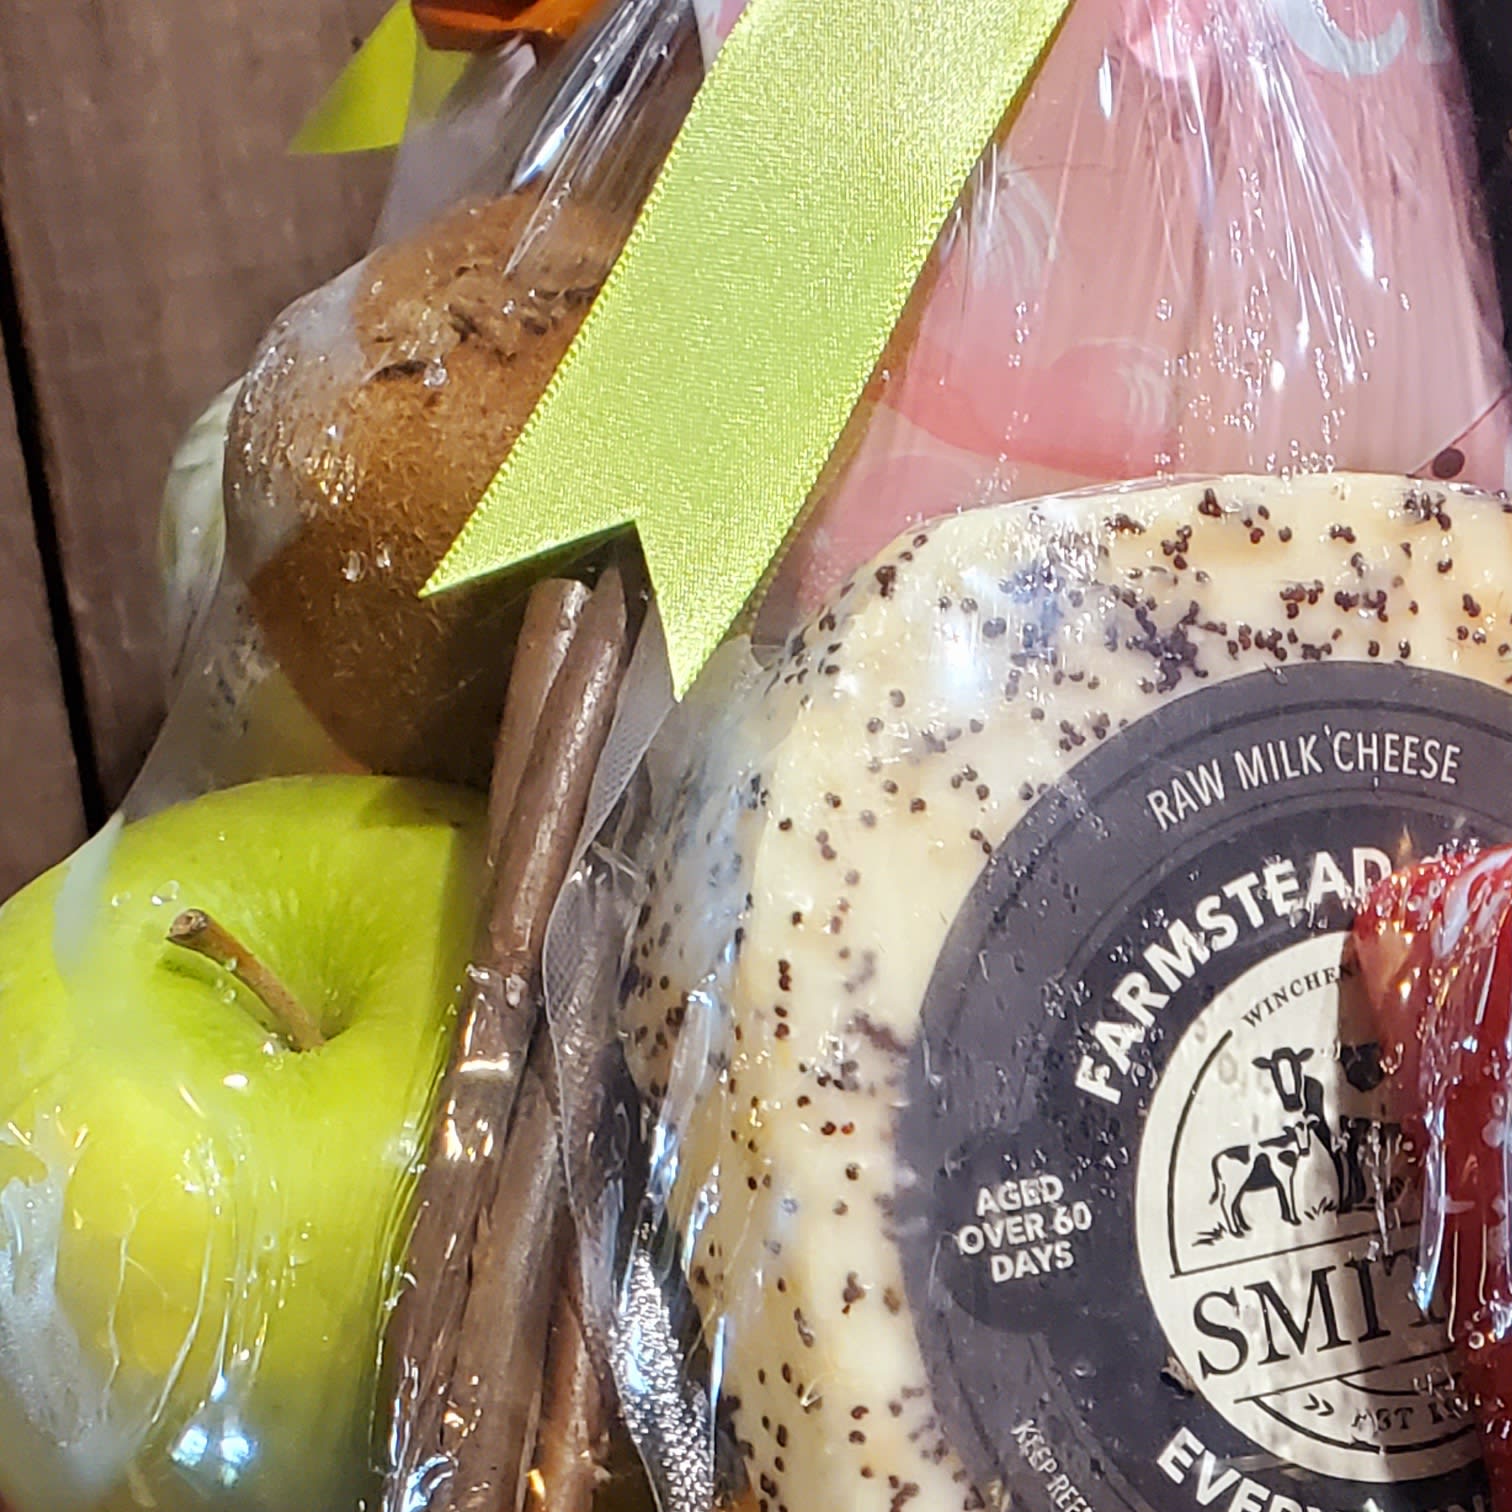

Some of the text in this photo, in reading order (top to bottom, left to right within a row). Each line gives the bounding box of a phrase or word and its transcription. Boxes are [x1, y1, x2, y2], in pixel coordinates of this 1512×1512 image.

[1146, 730, 1461, 830] RAW MILK CHEESE
[1075, 847, 1393, 1105] FARMSTEAD
[976, 1174, 1064, 1216] AGED
[958, 1201, 1093, 1255] OVER 60
[990, 1240, 1074, 1283] DAYS
[1011, 1420, 1058, 1473] KEEP
